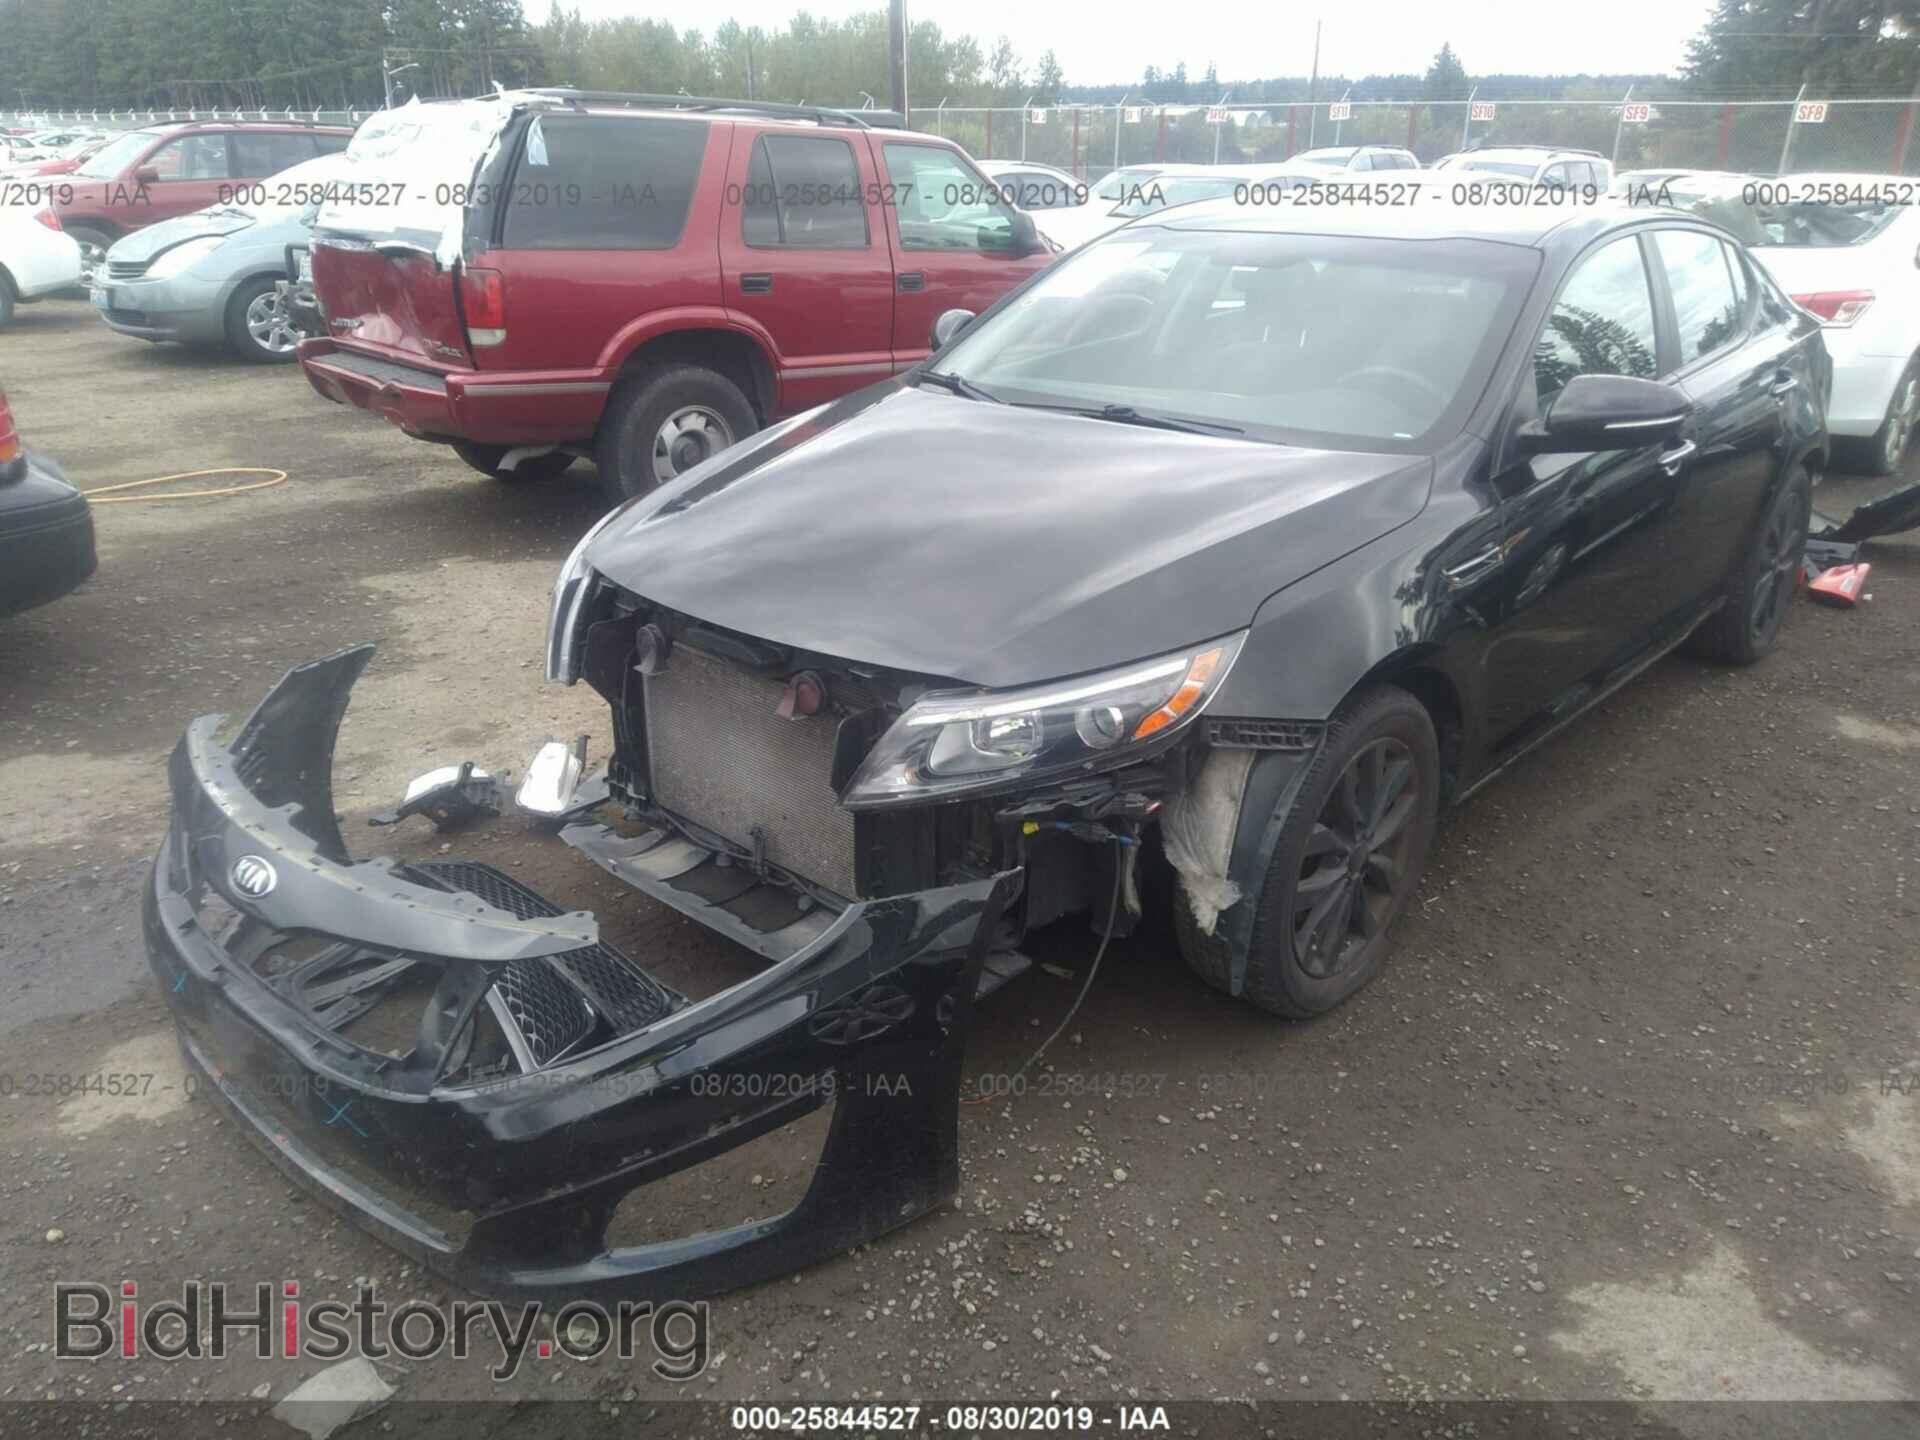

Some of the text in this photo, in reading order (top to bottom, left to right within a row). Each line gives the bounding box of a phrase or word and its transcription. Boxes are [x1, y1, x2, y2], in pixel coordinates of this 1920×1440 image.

[1472, 104, 1494, 119] SF10
[1625, 106, 1648, 120] SF9
[1799, 105, 1824, 120] SF8
[235, 859, 268, 894] KIA
